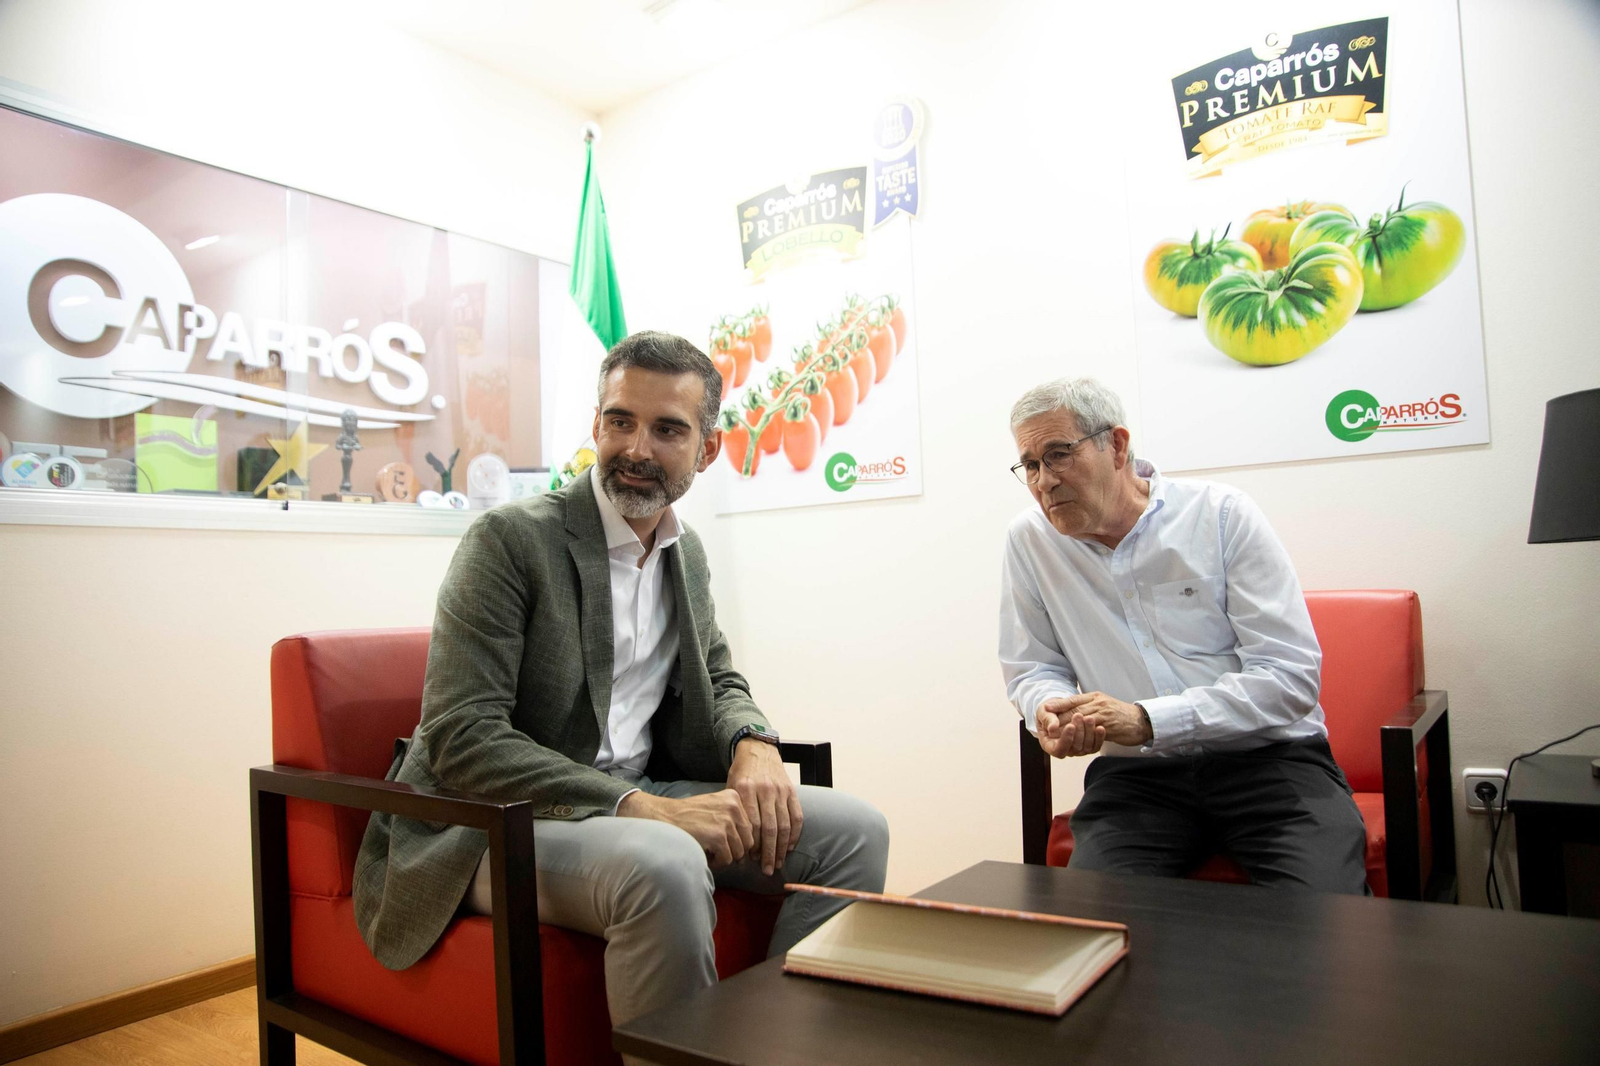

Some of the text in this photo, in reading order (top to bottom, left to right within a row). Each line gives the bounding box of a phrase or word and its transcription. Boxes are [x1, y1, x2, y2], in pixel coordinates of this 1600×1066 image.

[1214, 42, 1340, 92] Caparrós
[1180, 51, 1383, 129] PREMIUM
[1220, 107, 1294, 141] TOMATE
[1270, 118, 1322, 133] TOMATO
[875, 166, 916, 193] TASTE
[741, 189, 863, 244] PREMIUM
[763, 182, 837, 218] Caparrós
[761, 230, 844, 262] LOBELLO
[1340, 393, 1462, 430] CAPARRÓS
[1382, 414, 1439, 425] NATURE
[832, 456, 906, 483] CAPARRÓS
